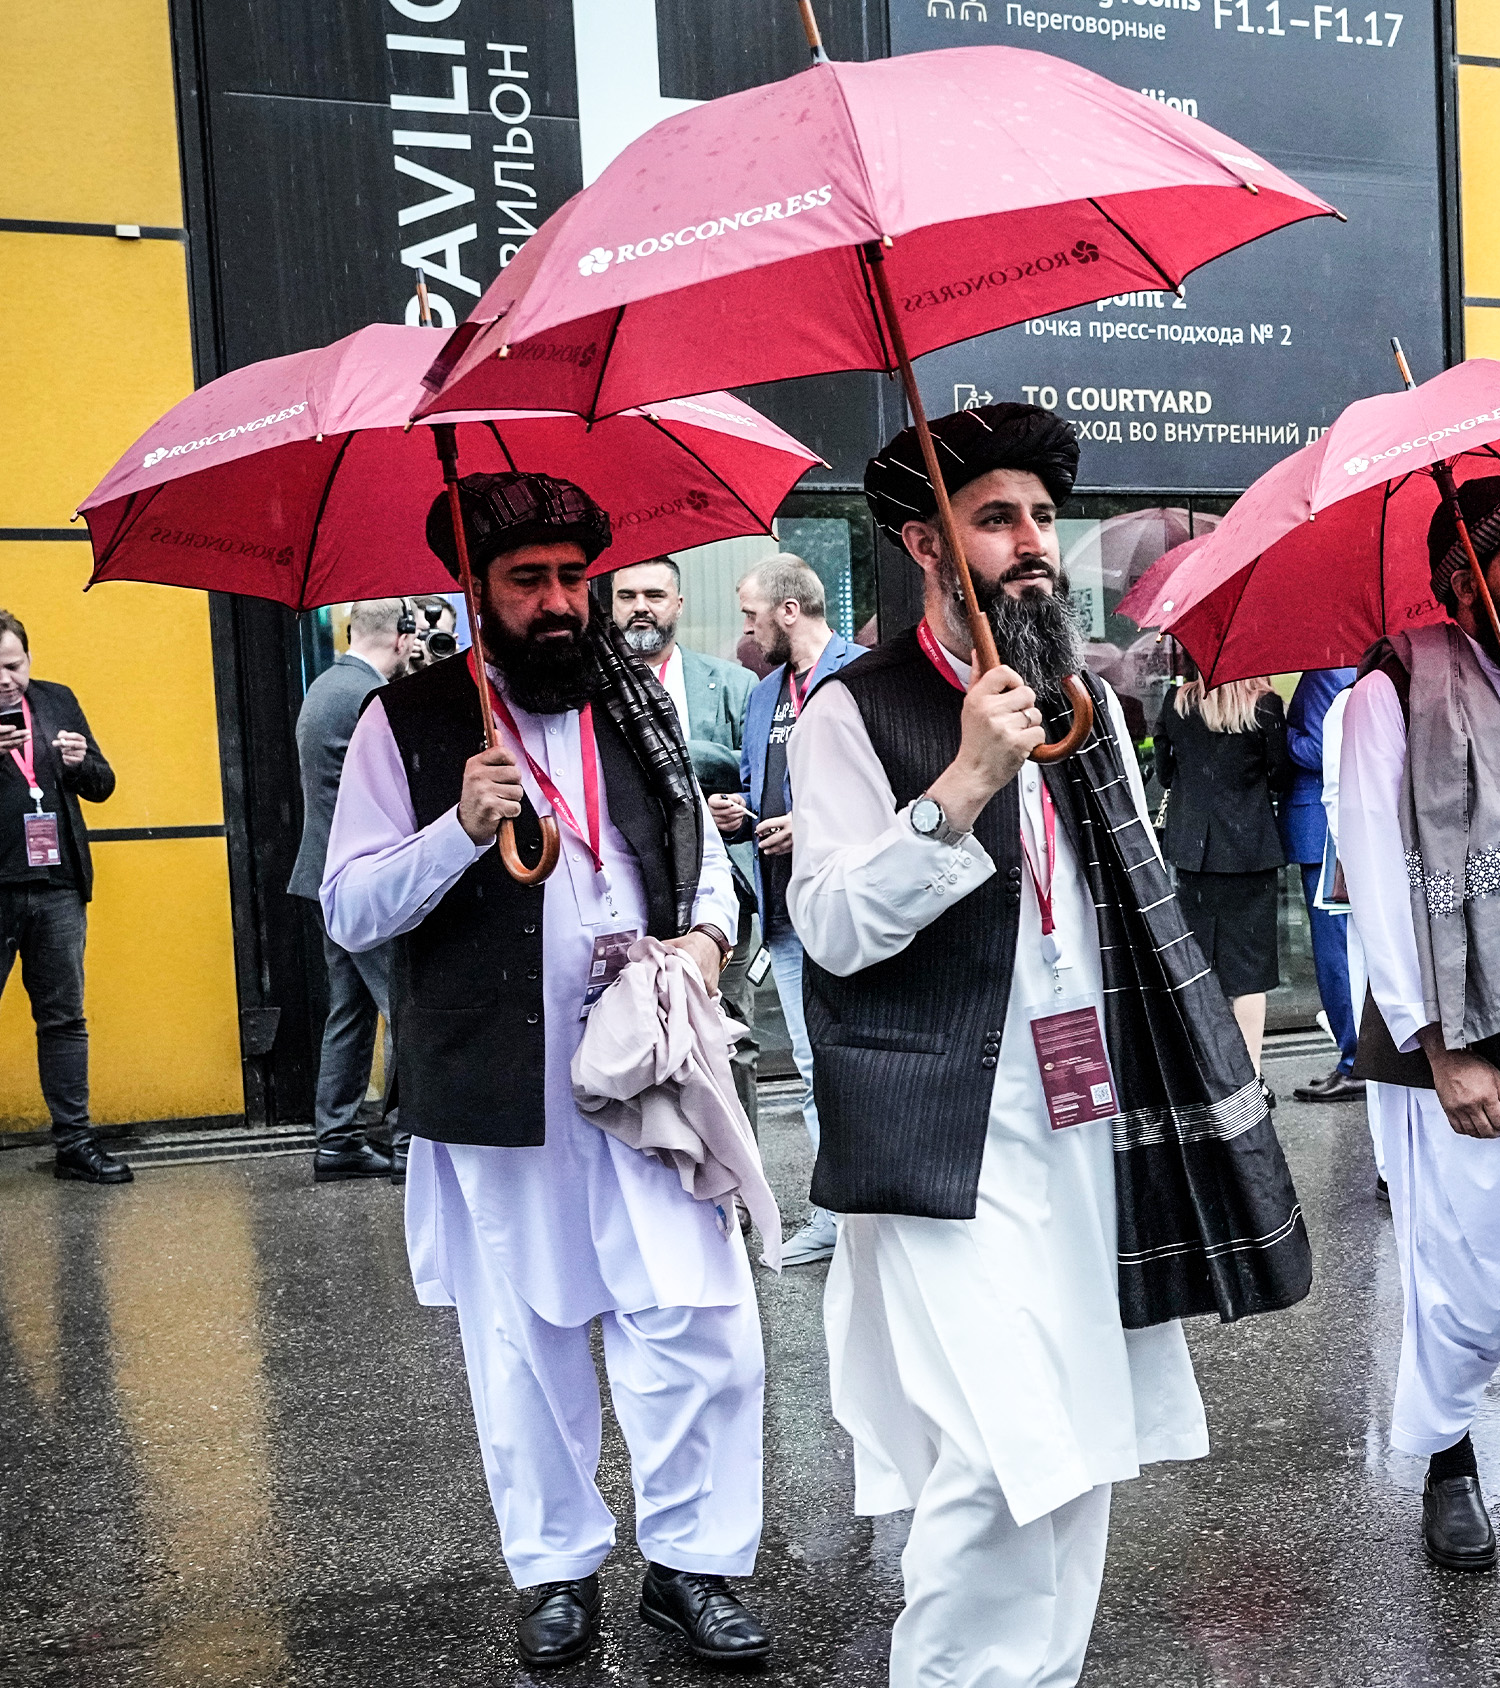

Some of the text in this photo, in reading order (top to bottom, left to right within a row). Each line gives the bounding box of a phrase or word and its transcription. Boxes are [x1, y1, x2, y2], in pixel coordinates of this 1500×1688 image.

[1006, 3, 1167, 41] Переговорные
[616, 184, 833, 264] ROSCONGRESS
[1089, 321, 1243, 345] пресс-подхода
[1281, 325, 1292, 346] 2
[1022, 386, 1212, 414] TO COURTYARD
[166, 401, 308, 459] ROSCONGRESS
[1130, 422, 1157, 442] ВО
[1164, 422, 1299, 446] ВНУТРЕННИЙ
